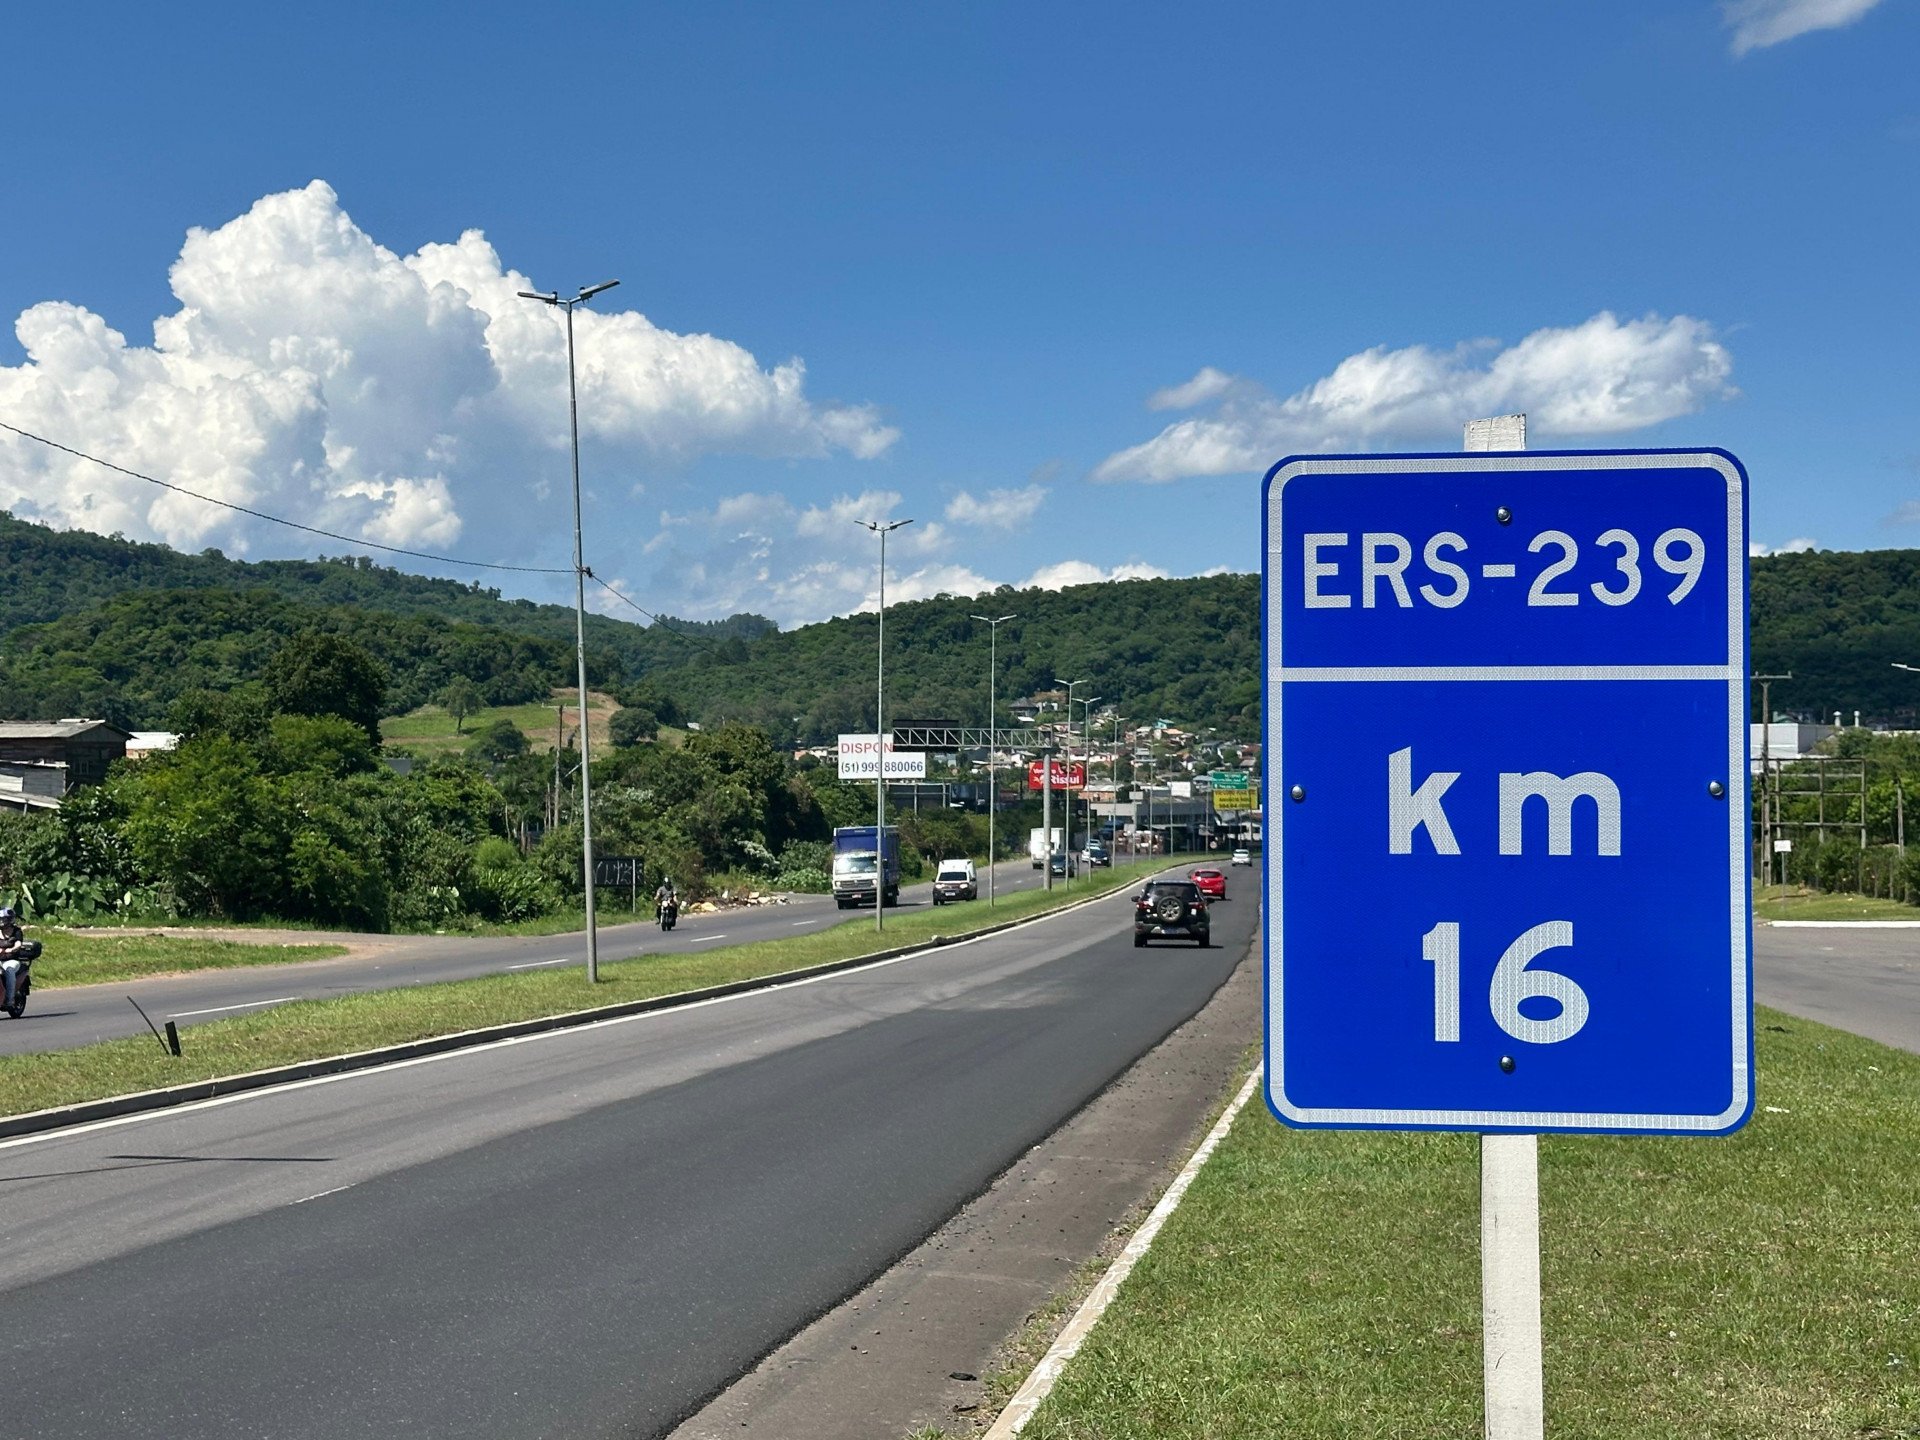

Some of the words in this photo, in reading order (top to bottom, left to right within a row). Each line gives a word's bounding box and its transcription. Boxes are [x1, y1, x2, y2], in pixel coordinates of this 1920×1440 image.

[1303, 528, 1706, 609] ERS-239
[841, 762, 859, 773] (51)
[884, 761, 923, 772] 880066
[1388, 747, 1621, 856] km
[1423, 920, 1590, 1044] 16
